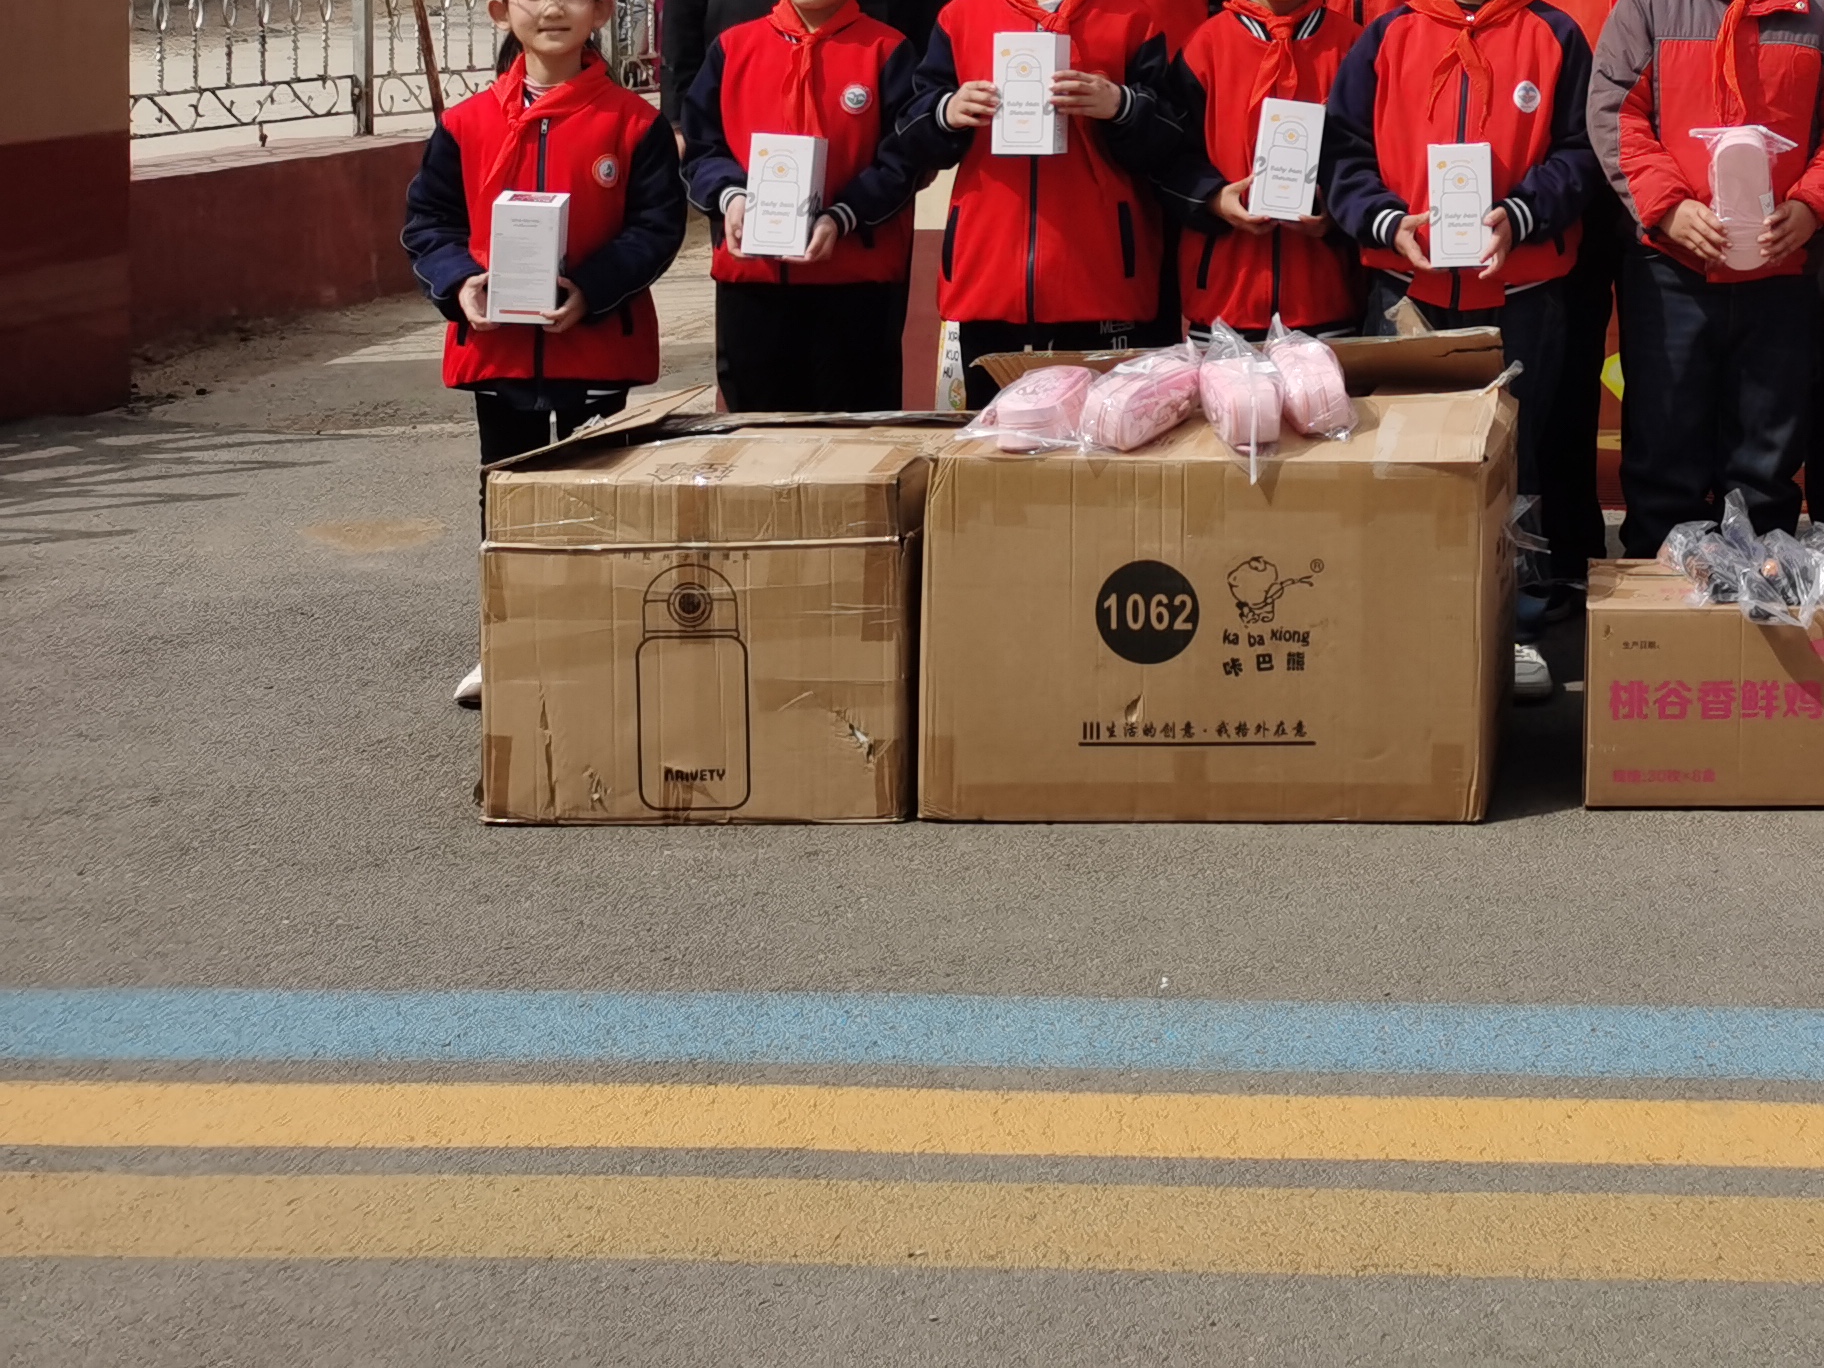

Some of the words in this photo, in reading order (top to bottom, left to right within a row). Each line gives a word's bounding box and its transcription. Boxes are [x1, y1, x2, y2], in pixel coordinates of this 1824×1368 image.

[1111, 335, 1128, 350] 10
[1103, 592, 1194, 631] 1062
[1222, 628, 1240, 645] ka
[1247, 633, 1265, 647] ba
[1269, 626, 1311, 647] xiong
